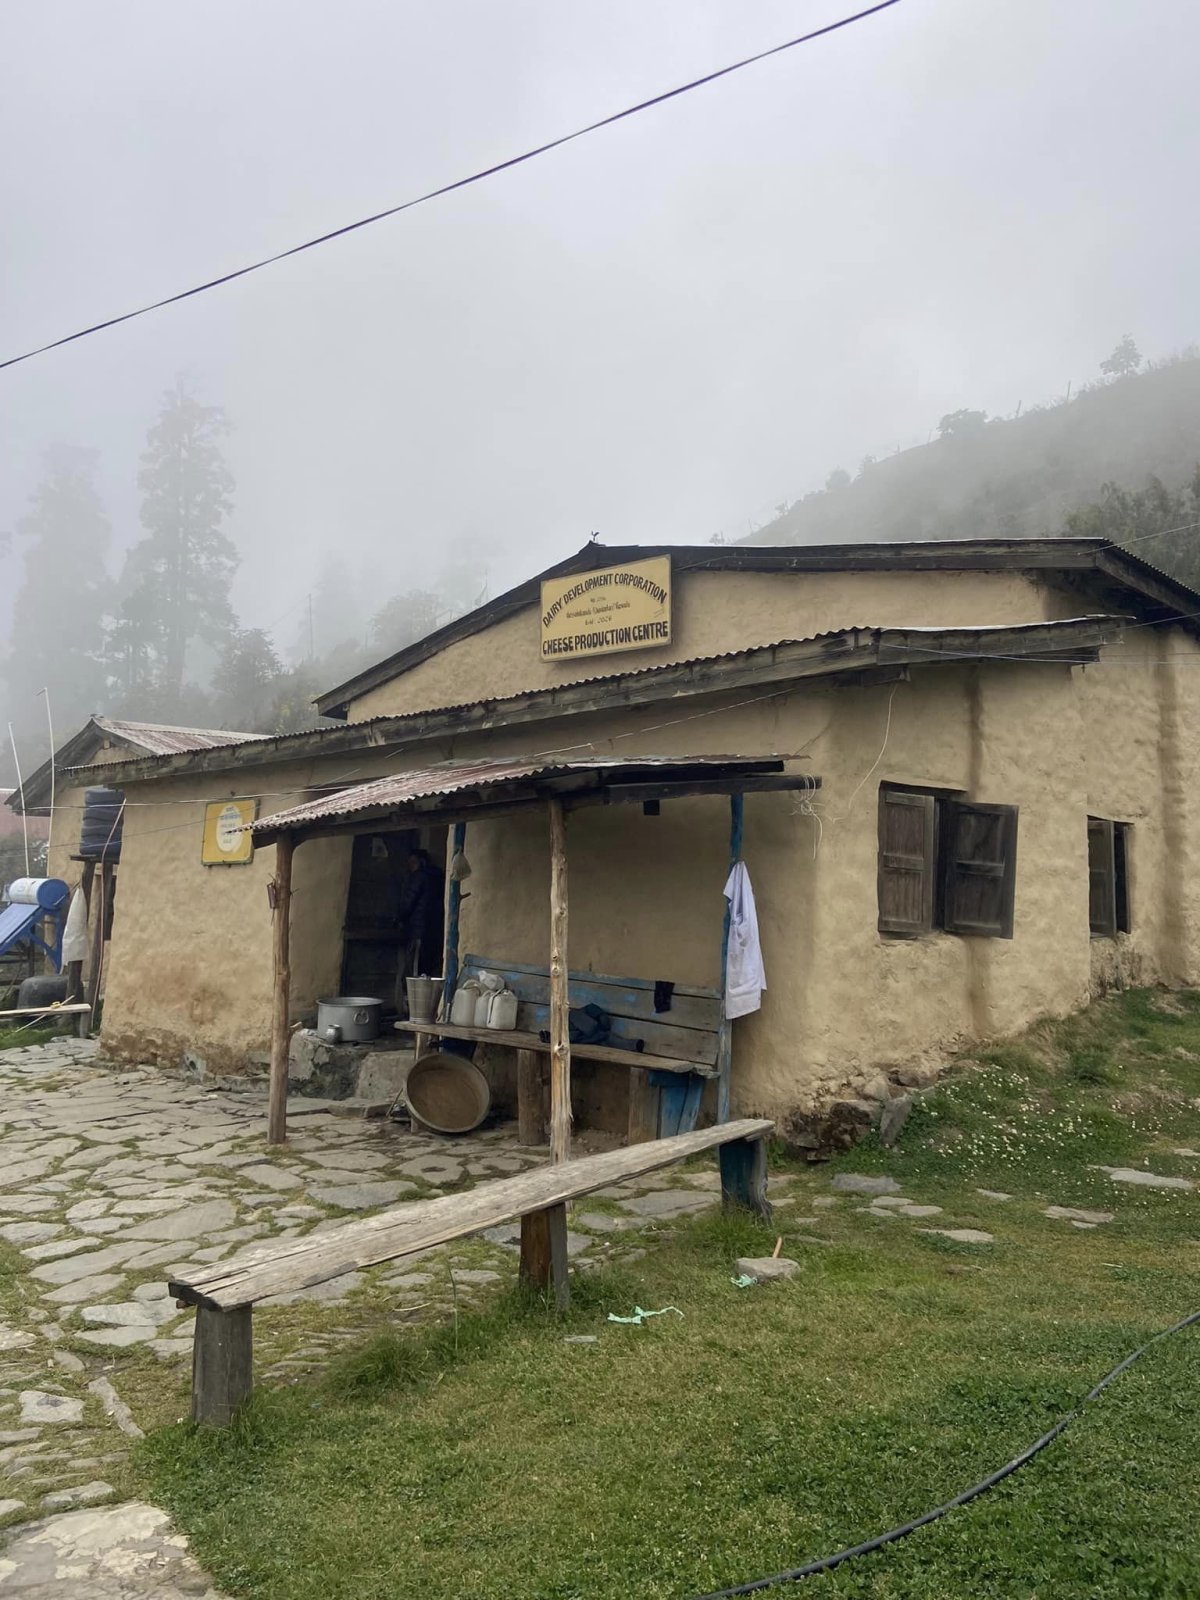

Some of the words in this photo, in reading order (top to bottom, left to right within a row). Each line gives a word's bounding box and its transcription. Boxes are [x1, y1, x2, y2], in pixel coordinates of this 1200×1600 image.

[542, 597, 563, 628] DAIRY
[563, 574, 614, 604] DEVELOPMENT
[614, 573, 667, 604] CORPORATION
[542, 636, 574, 655] CHEESE
[575, 626, 631, 650] PRODUCTION
[632, 621, 668, 641] CENTRE
